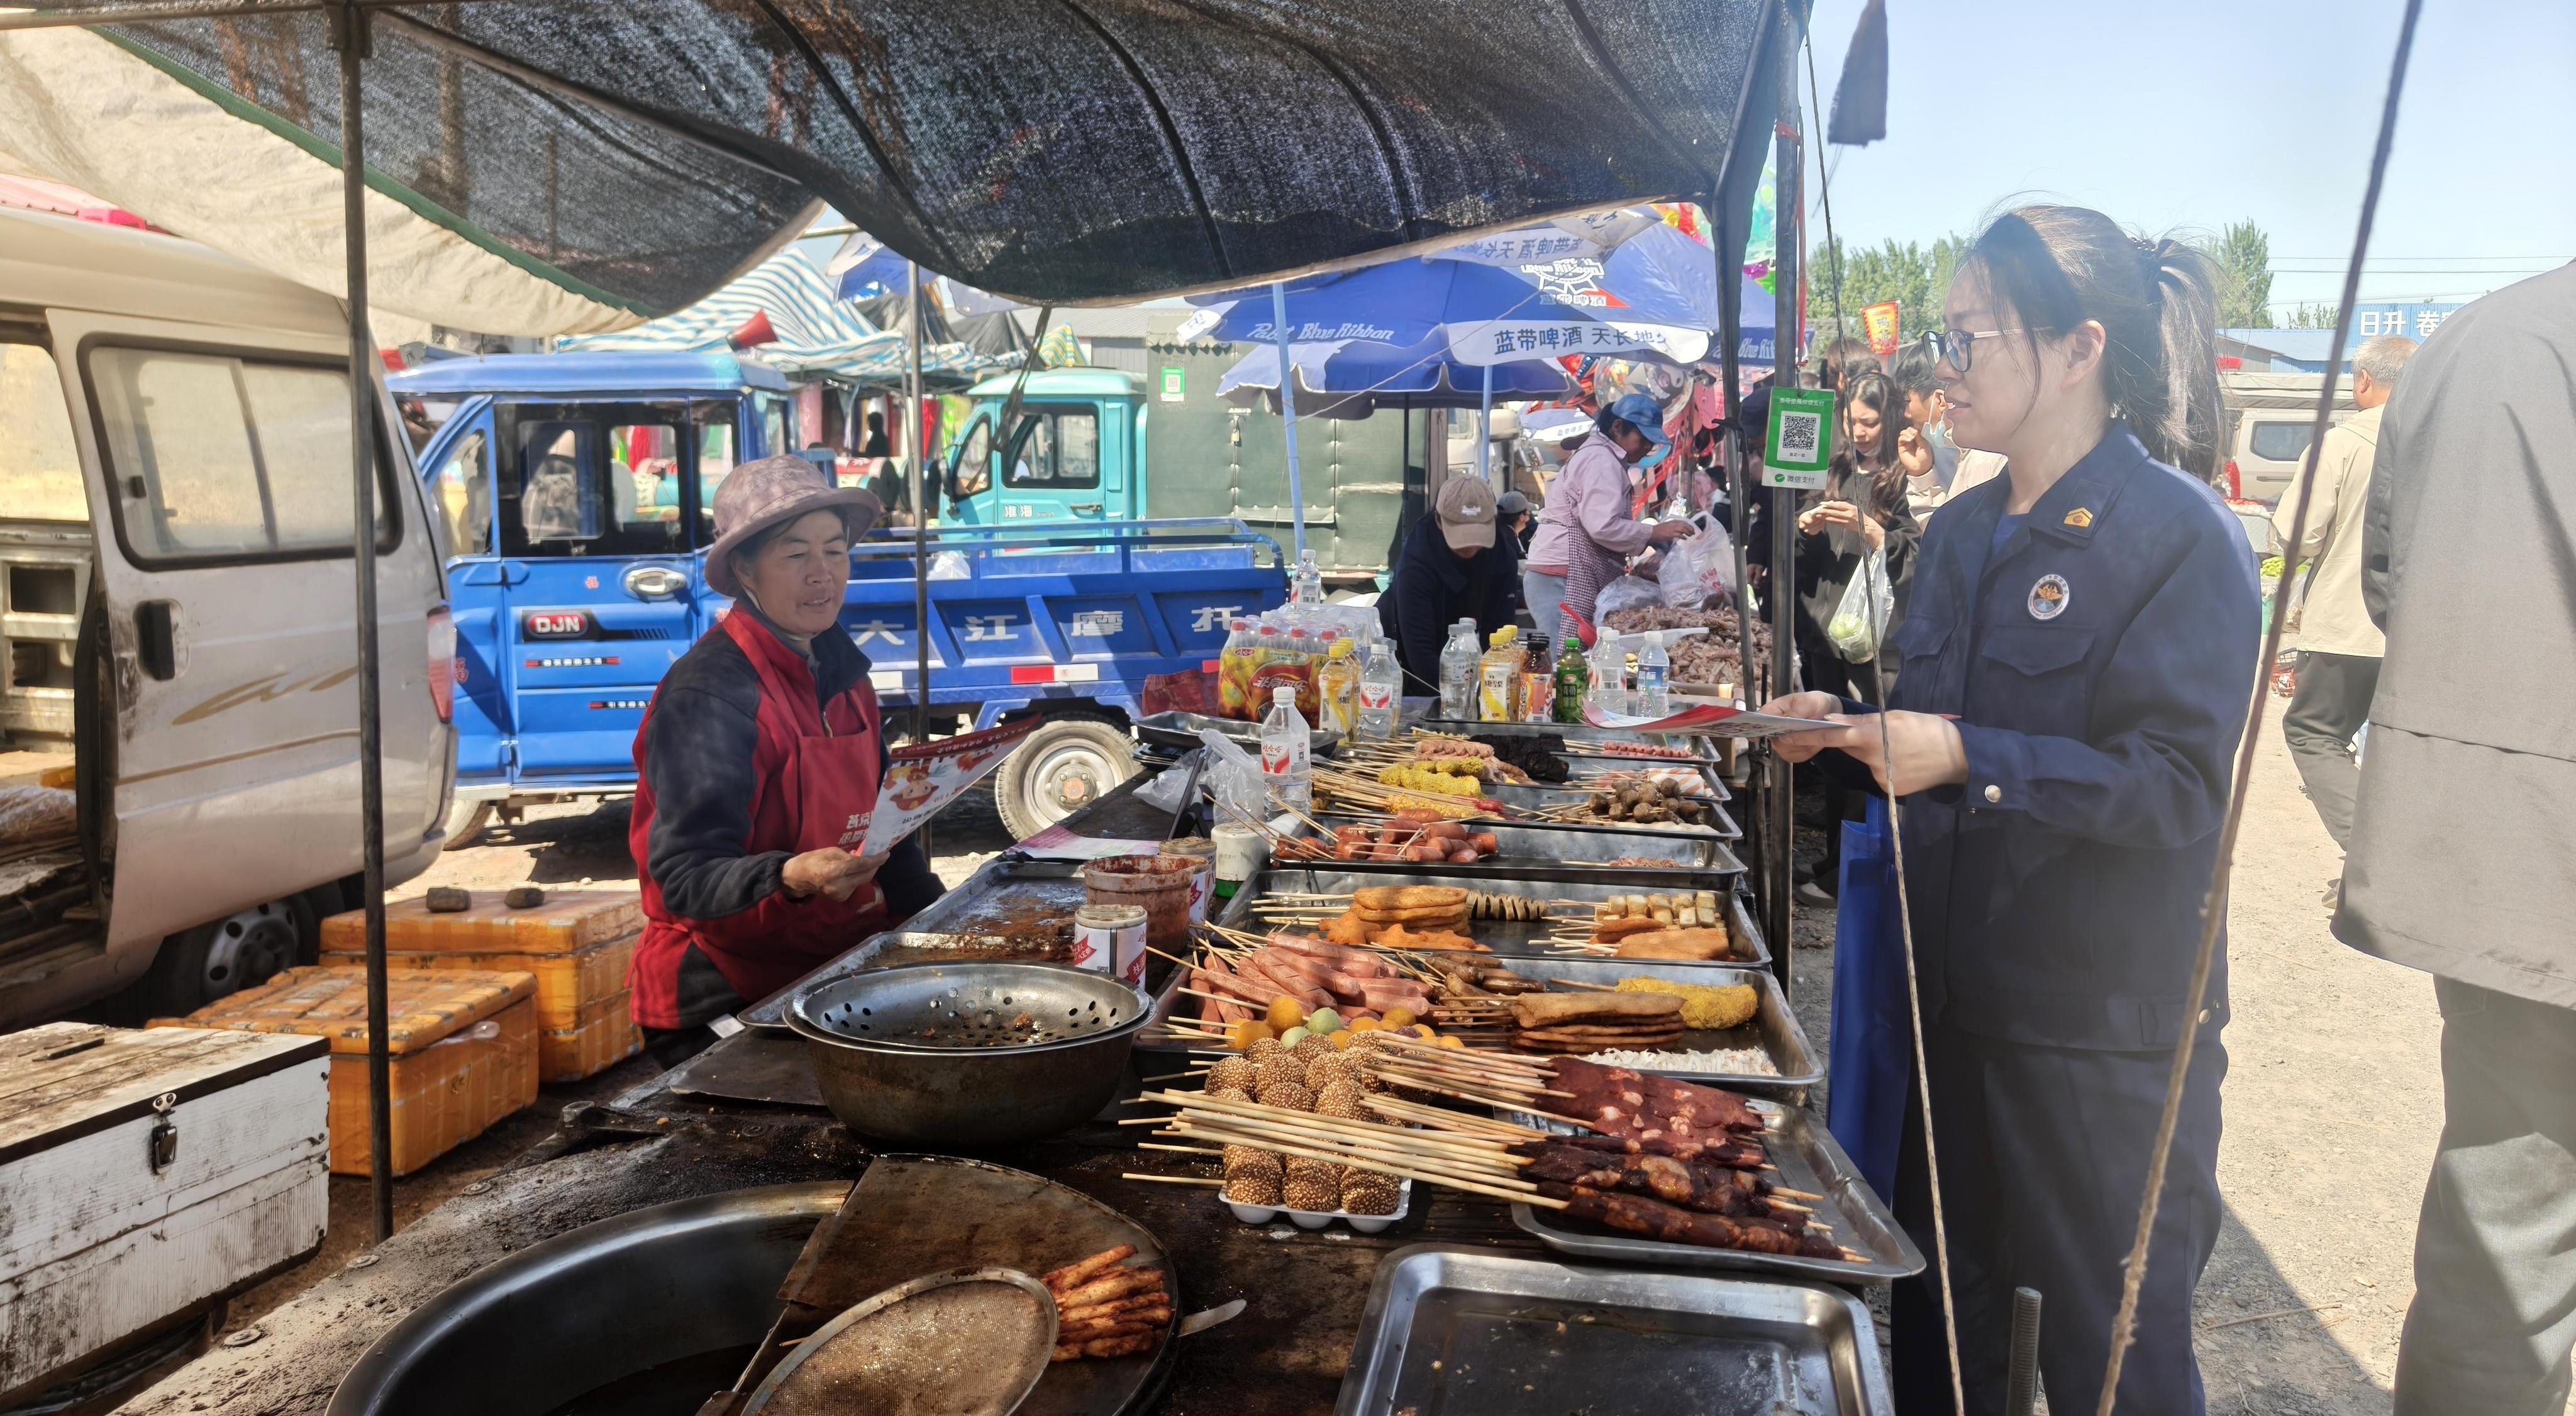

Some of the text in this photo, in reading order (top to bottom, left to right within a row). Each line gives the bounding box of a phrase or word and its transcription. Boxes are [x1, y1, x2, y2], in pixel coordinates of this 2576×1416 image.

[1246, 322, 1395, 341] Pabt Blue Ribbon
[2360, 310, 2452, 338] 日升 卷
[1494, 326, 1582, 355] 蓝带啤酒
[1787, 475, 1815, 484] 微信支付
[535, 616, 580, 634] DJN
